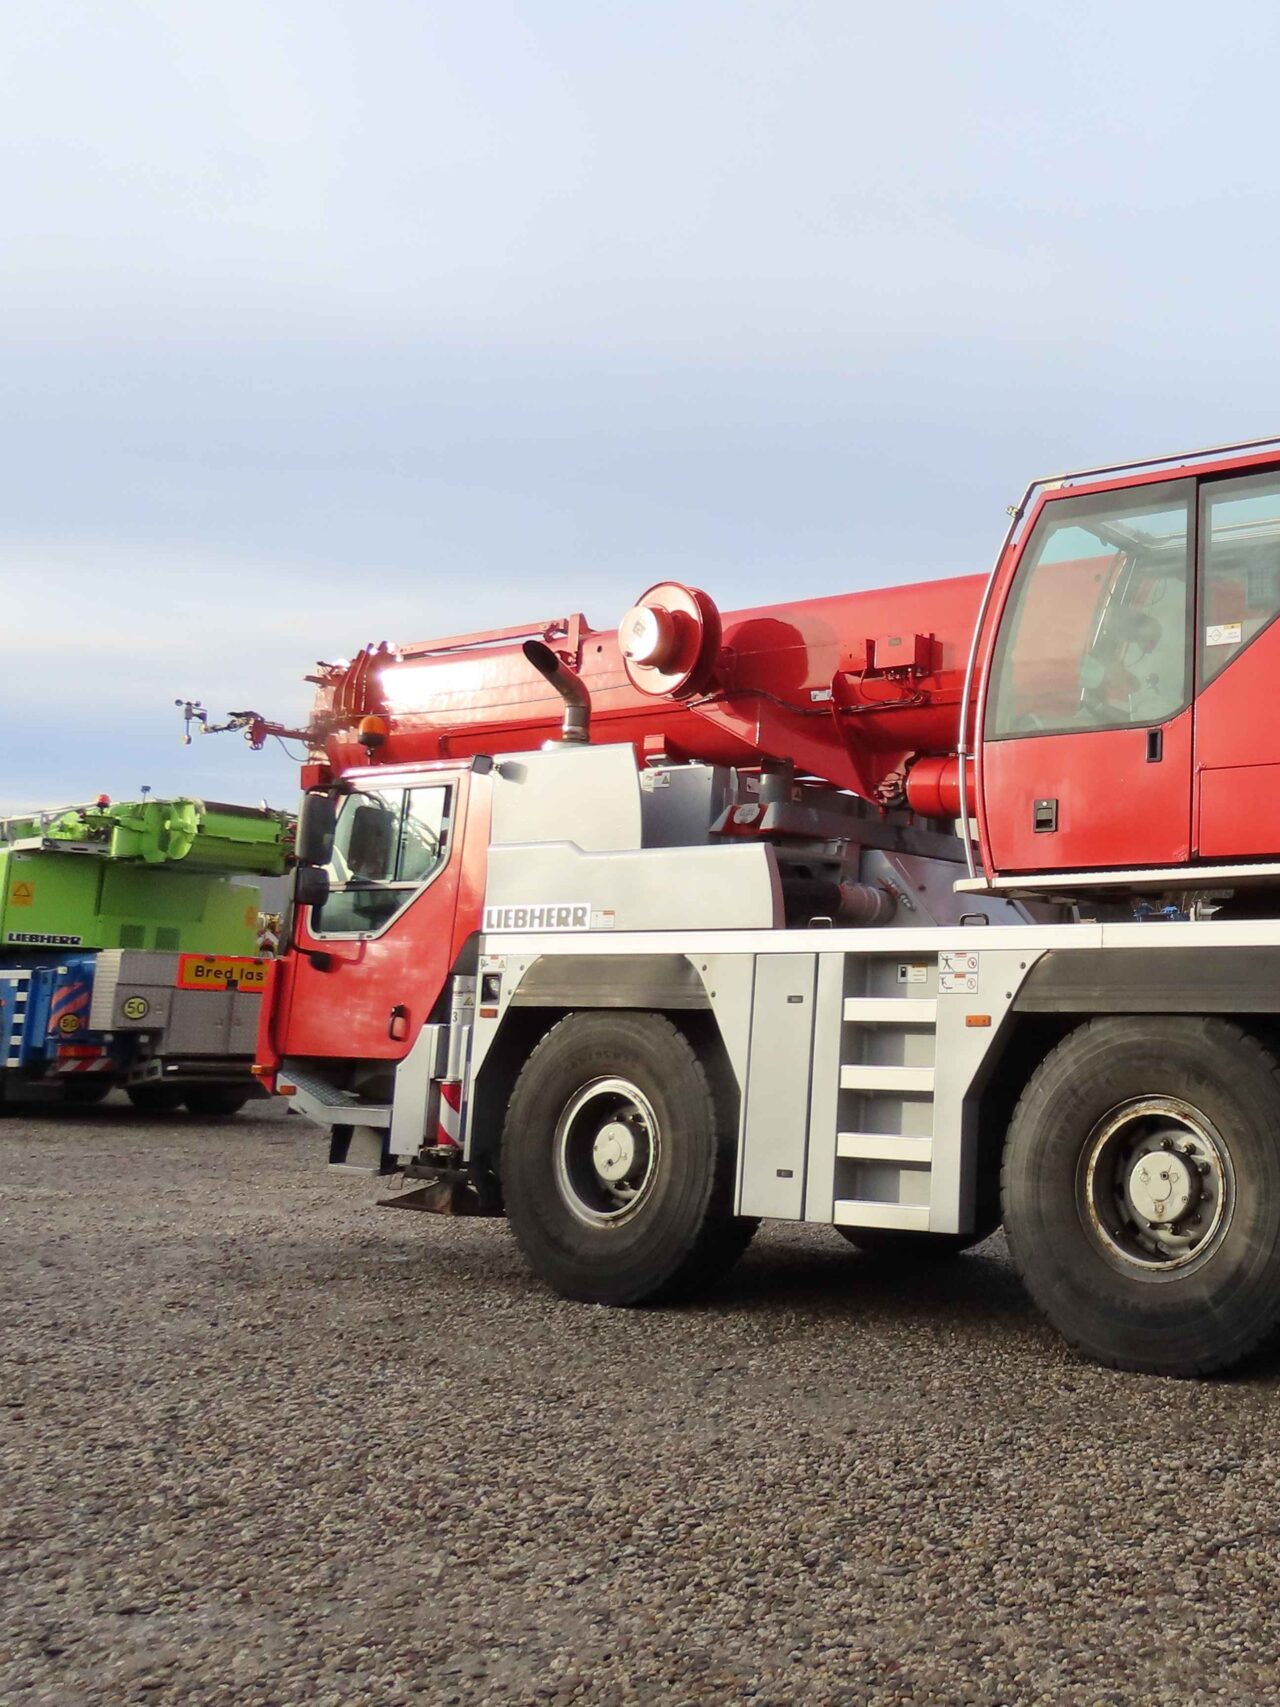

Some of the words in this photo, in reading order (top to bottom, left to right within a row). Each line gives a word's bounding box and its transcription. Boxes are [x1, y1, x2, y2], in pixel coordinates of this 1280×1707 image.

[486, 907, 588, 928] LIEBHERR
[8, 933, 81, 945] LIEBHERR
[195, 965, 234, 979] Bred
[127, 1001, 146, 1014] 50
[62, 1018, 78, 1028] 50
[452, 1011, 458, 1023] 3
